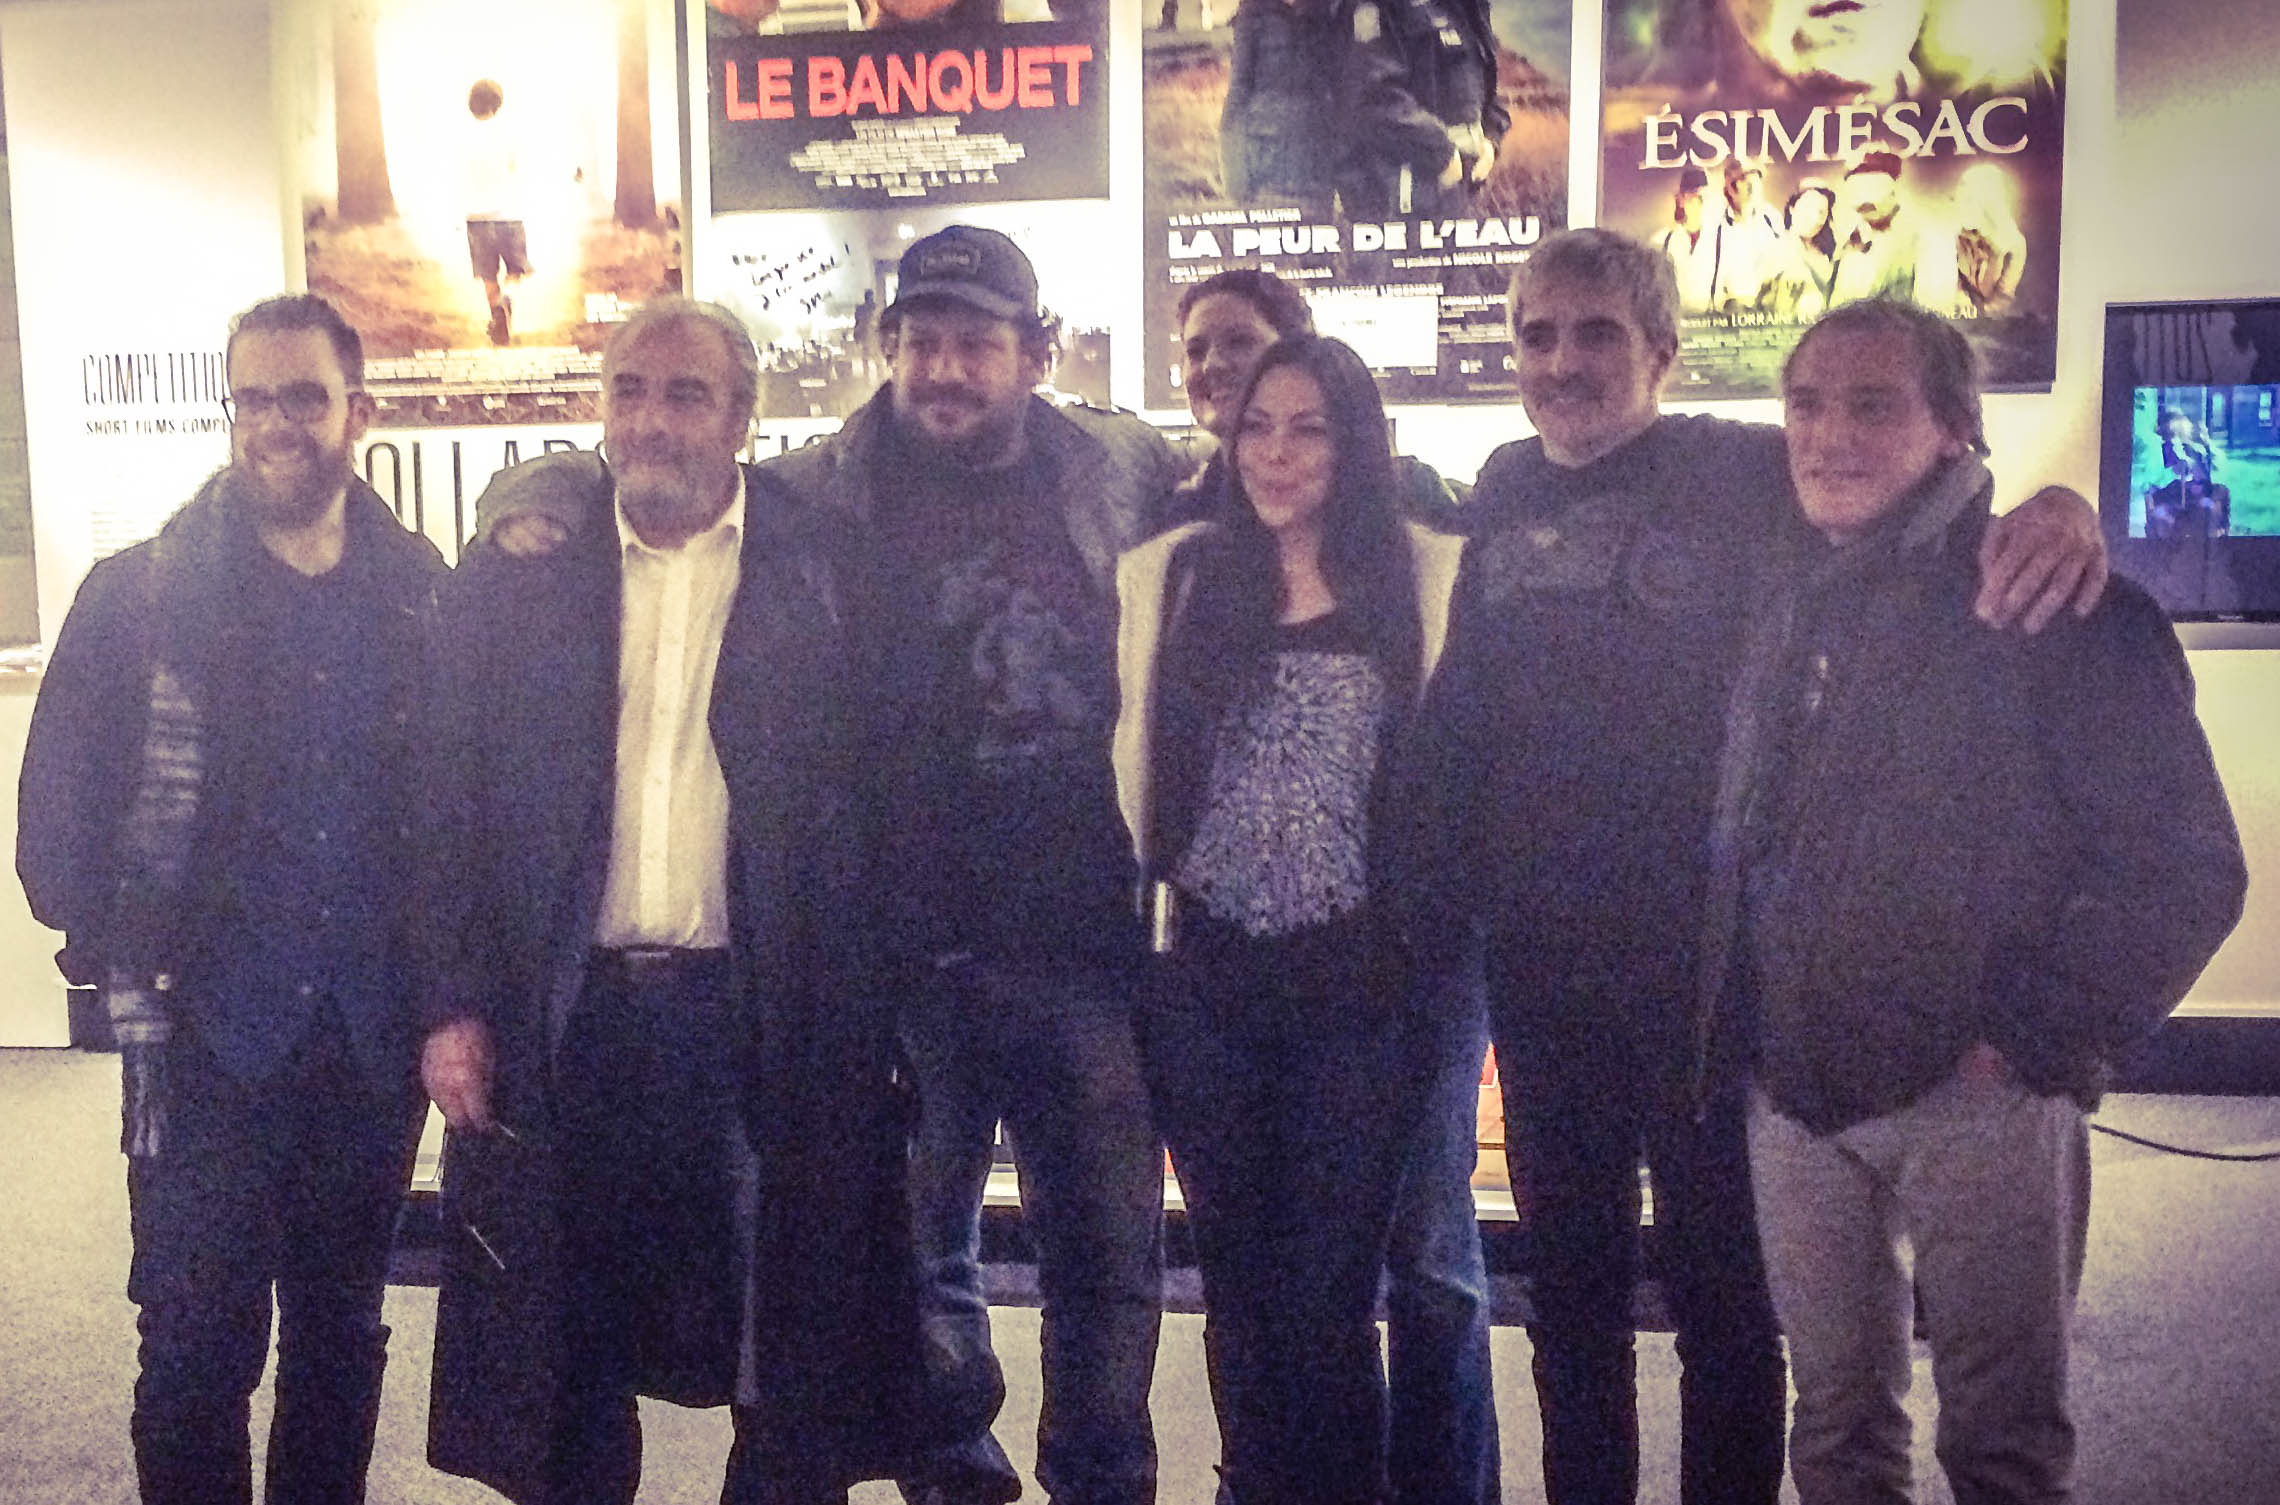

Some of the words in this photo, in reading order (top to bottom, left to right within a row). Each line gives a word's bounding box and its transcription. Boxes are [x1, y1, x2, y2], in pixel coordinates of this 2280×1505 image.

[725, 58, 795, 121] LE
[807, 45, 1093, 117] BANQUET
[1638, 93, 2029, 170] ÉSIMÉSAC
[1168, 229, 1222, 259] LA
[1233, 225, 1341, 257] PEUR
[1353, 221, 1408, 251] DE
[1420, 215, 1541, 250] L'EAU
[82, 351, 227, 405] COMPETITIO
[86, 419, 129, 435] SHORT
[135, 418, 177, 435] FILMS
